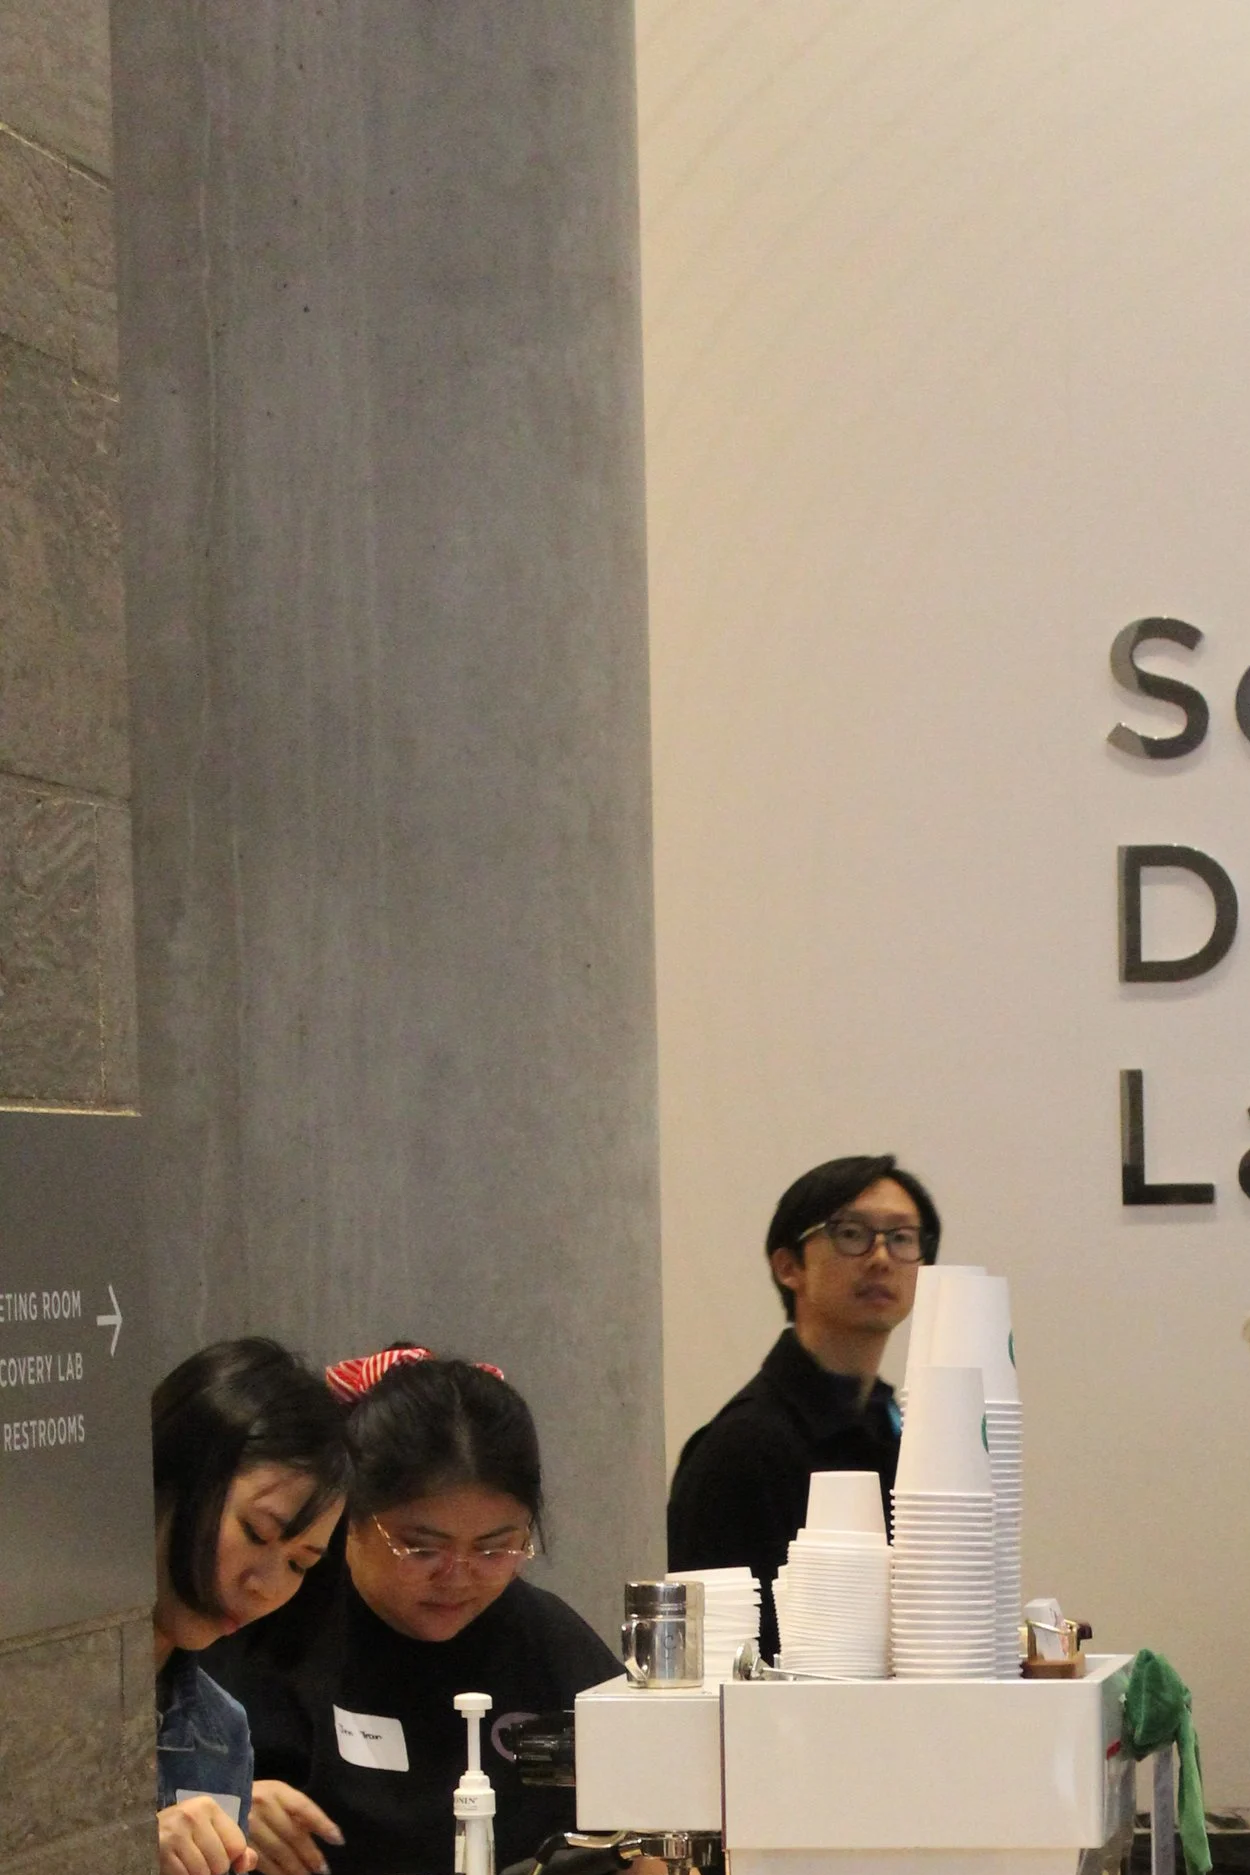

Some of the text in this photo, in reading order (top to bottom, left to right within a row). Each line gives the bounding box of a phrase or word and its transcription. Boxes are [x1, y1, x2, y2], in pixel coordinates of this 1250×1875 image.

[43, 1290, 82, 1319] ROOM
[0, 1352, 84, 1388] COVERY LAB
[3, 1414, 86, 1451] RESTROOMS
